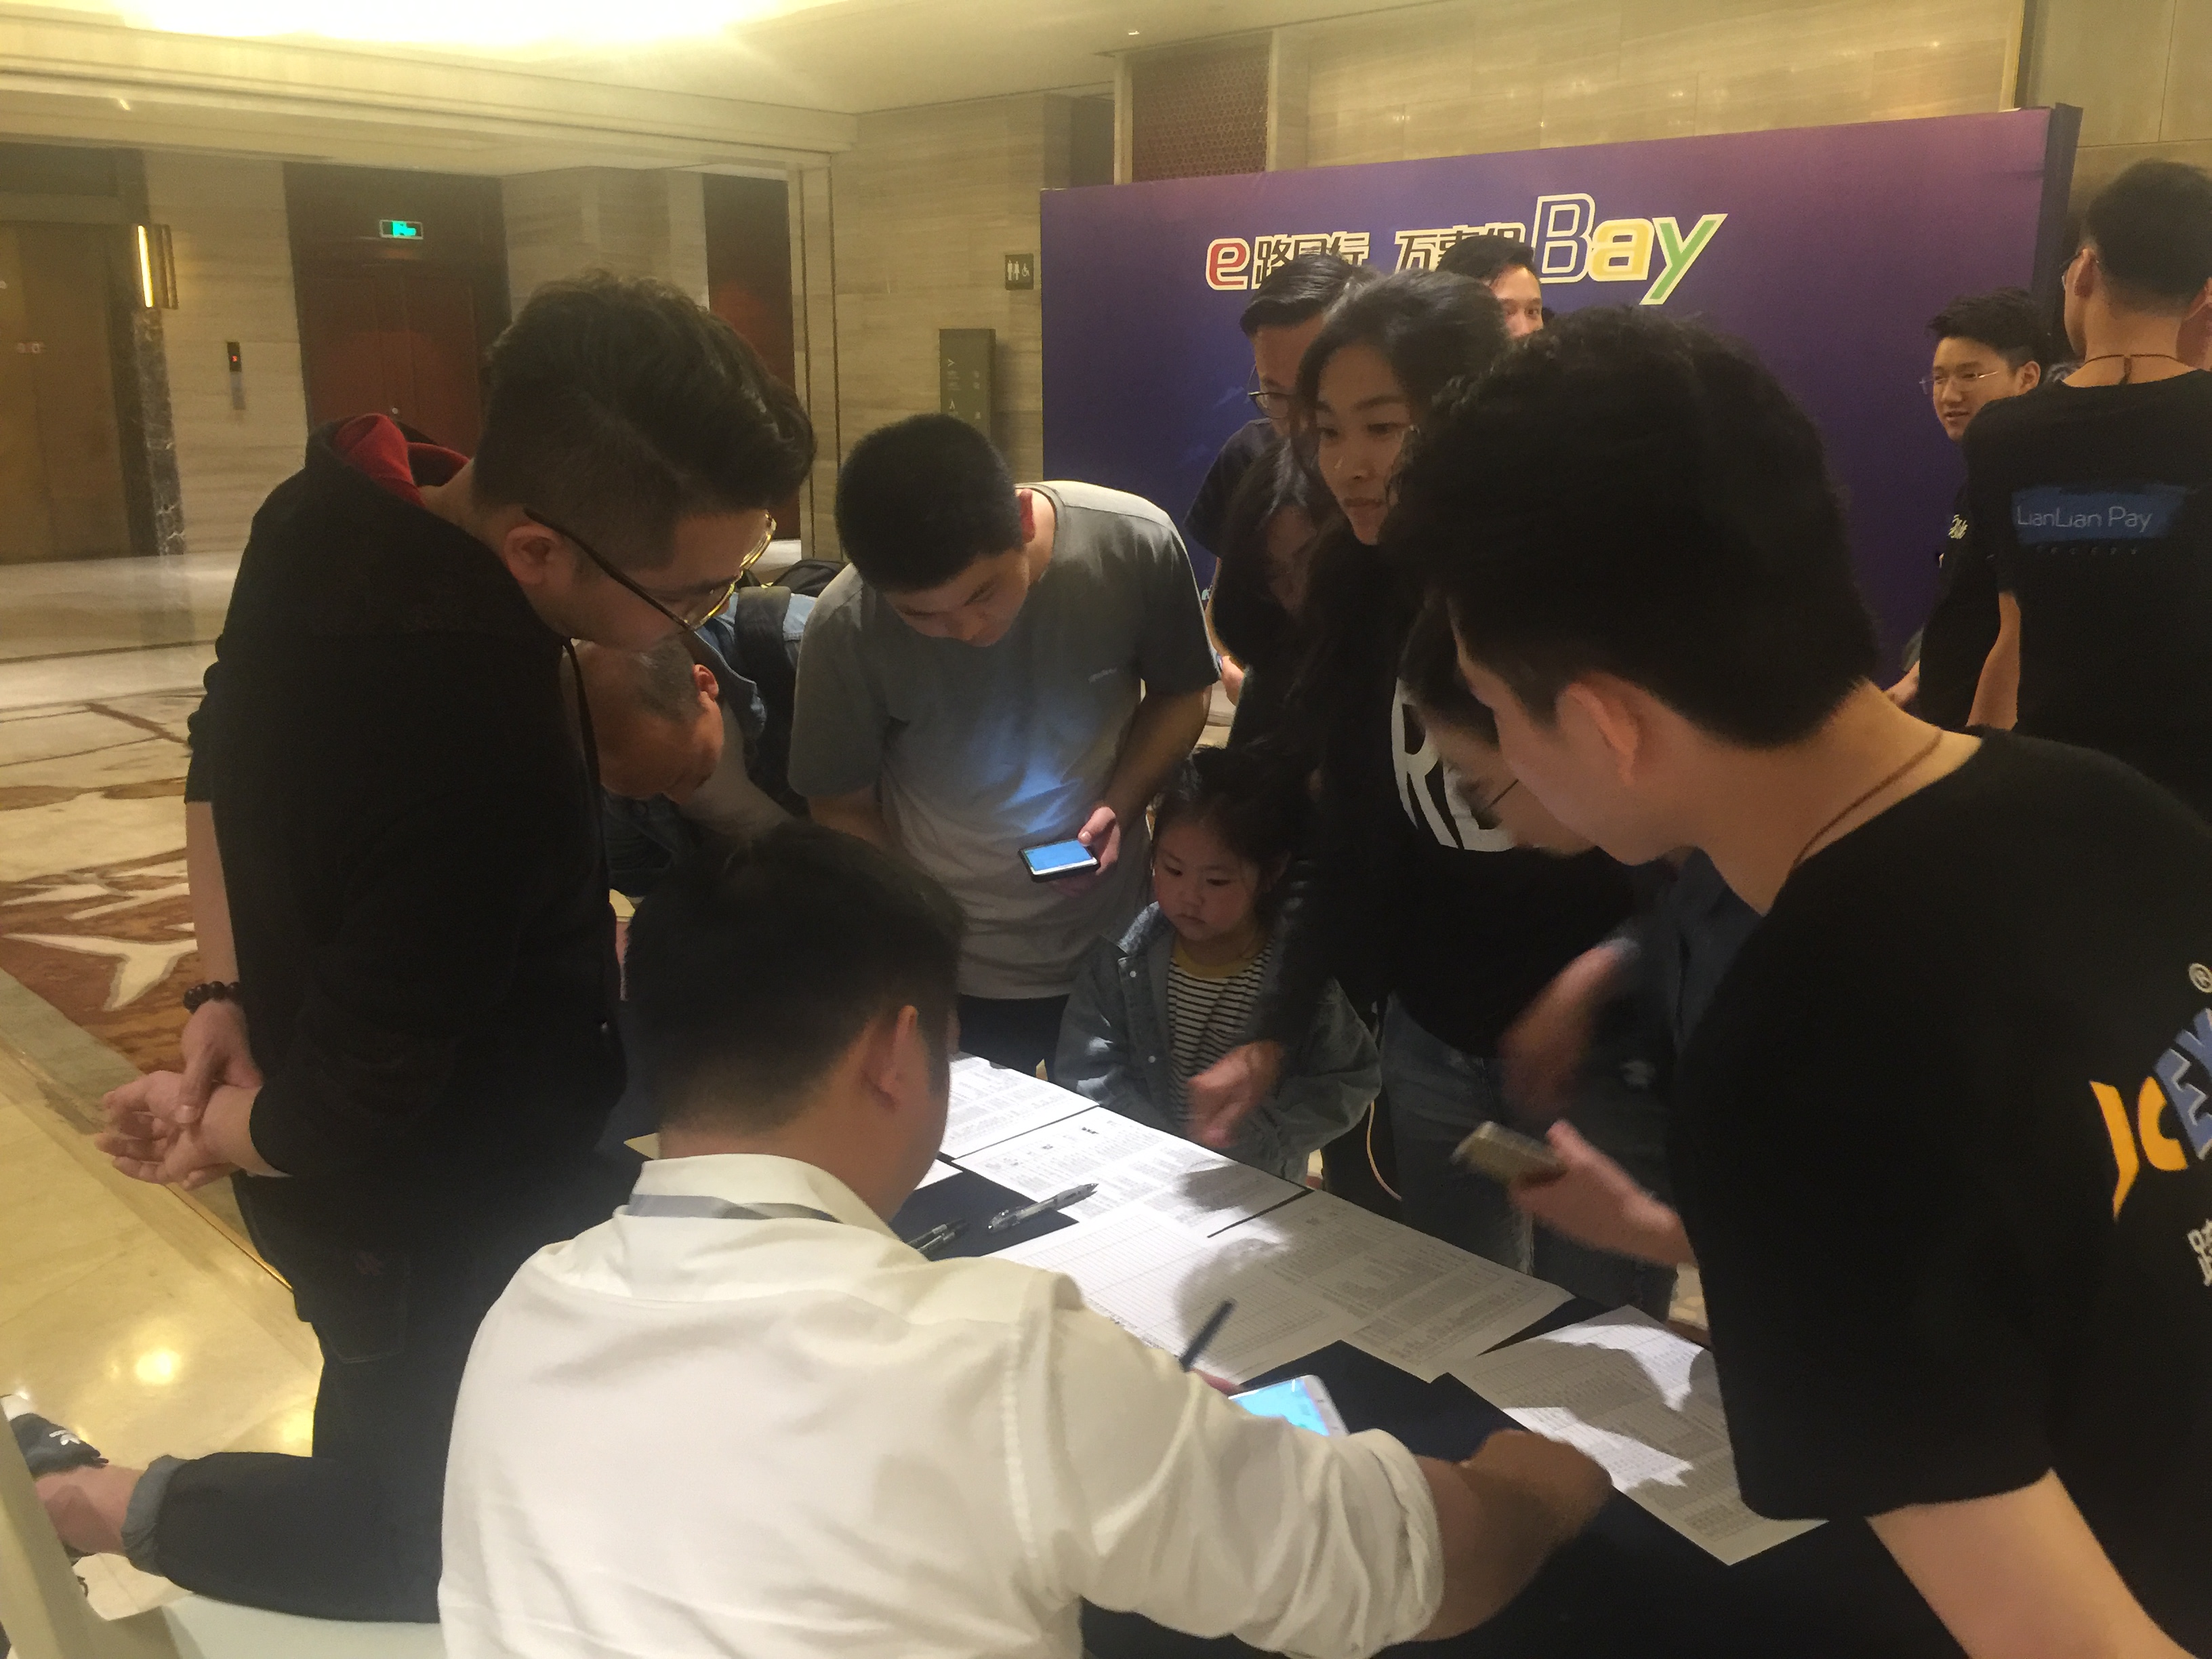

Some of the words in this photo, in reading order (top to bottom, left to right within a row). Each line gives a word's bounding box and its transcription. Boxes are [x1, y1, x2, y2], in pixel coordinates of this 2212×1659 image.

[1394, 192, 1728, 305] 万Bay
[2017, 506, 2102, 528] LianLian
[2108, 506, 2152, 533] Pay
